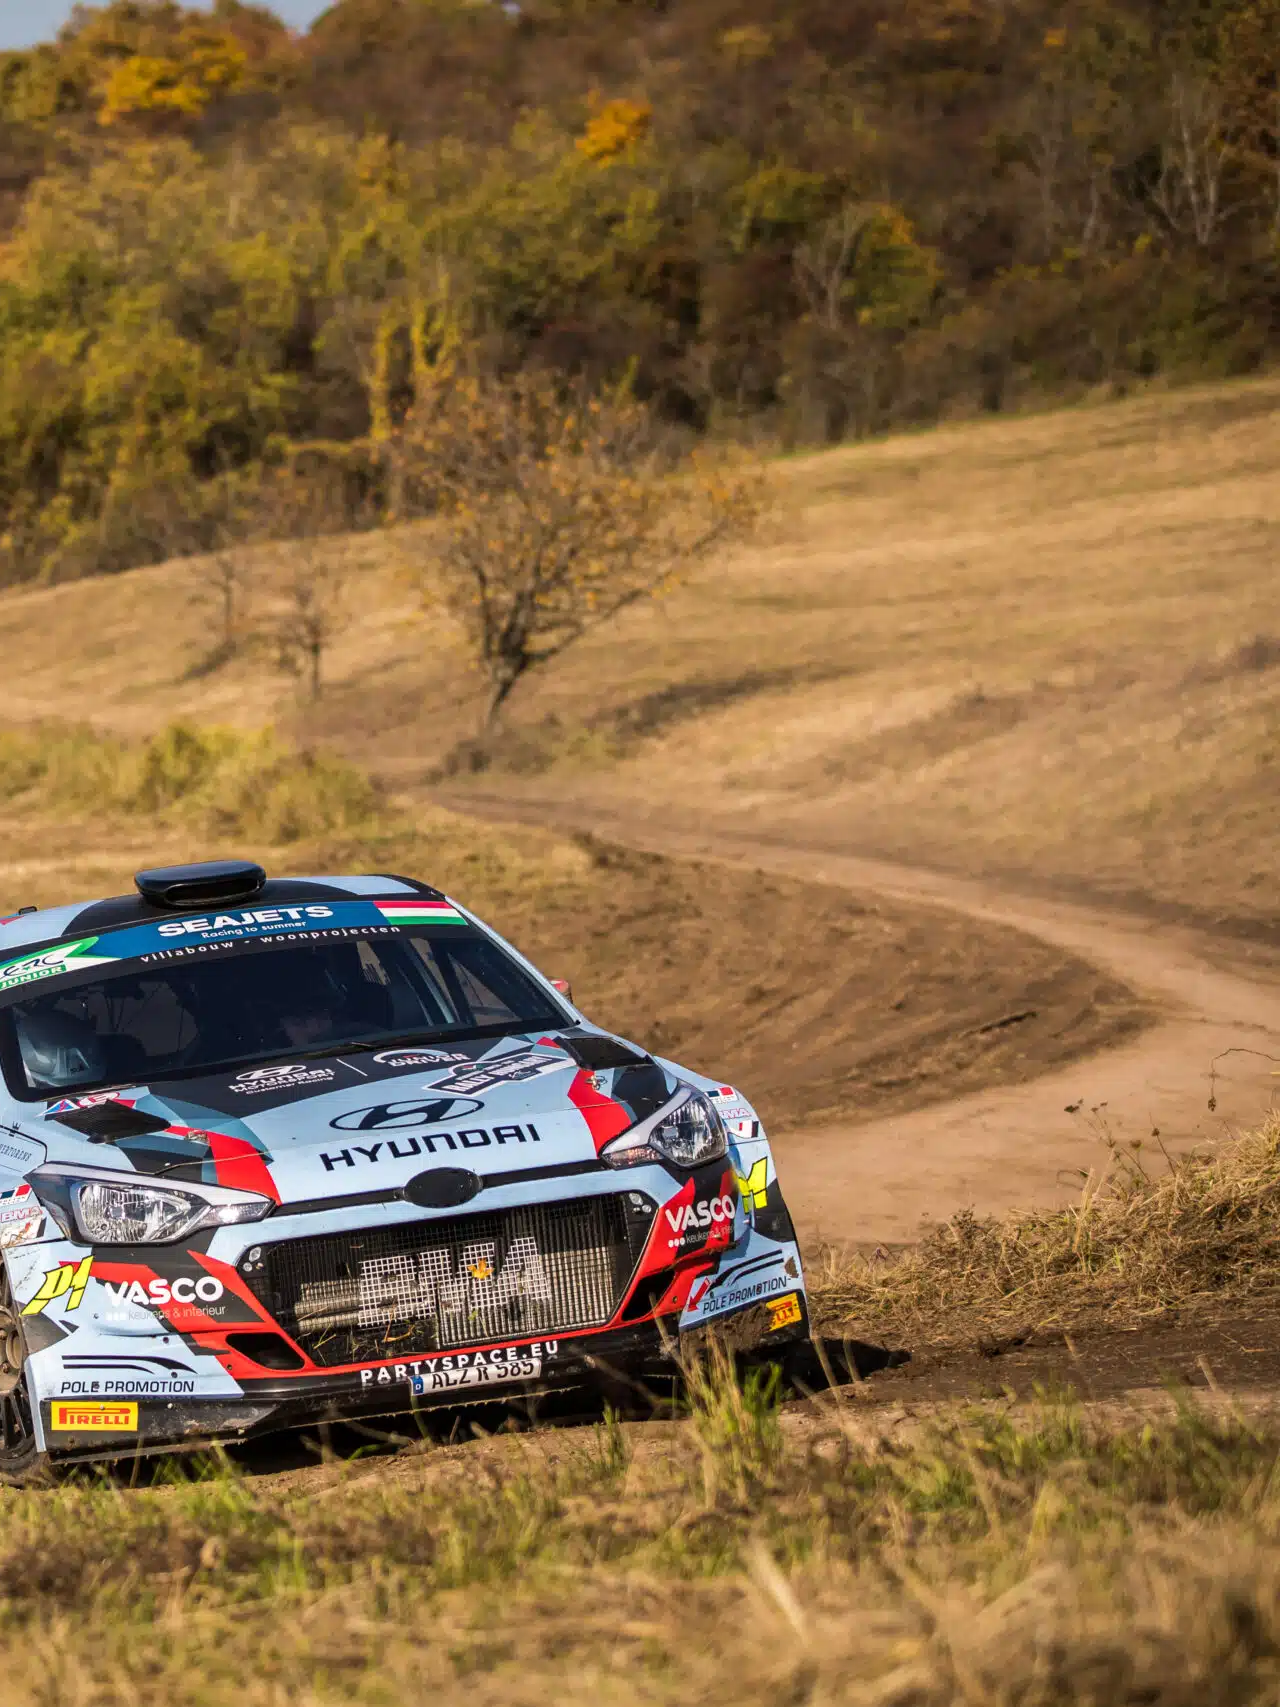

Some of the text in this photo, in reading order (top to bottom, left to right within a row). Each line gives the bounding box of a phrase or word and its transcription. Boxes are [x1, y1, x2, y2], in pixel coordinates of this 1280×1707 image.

[157, 905, 333, 938] SEAJETS
[201, 920, 307, 940] Racing to summer
[140, 938, 234, 963] villabouw
[260, 925, 401, 944] woonprojecten
[0, 965, 63, 989] JUNIOR
[228, 1068, 333, 1090] HYUNDAI
[319, 1123, 541, 1171] HYUNDAI
[665, 1194, 736, 1233] VASCO
[104, 1276, 224, 1307] VASCO
[703, 1277, 787, 1315] POLE PROMOTION
[360, 1341, 559, 1384] PARTYSPACE.EU
[496, 1360, 535, 1379] 585
[61, 1380, 195, 1394] POLE PROMOTION
[59, 1407, 132, 1425] PIRELLI
